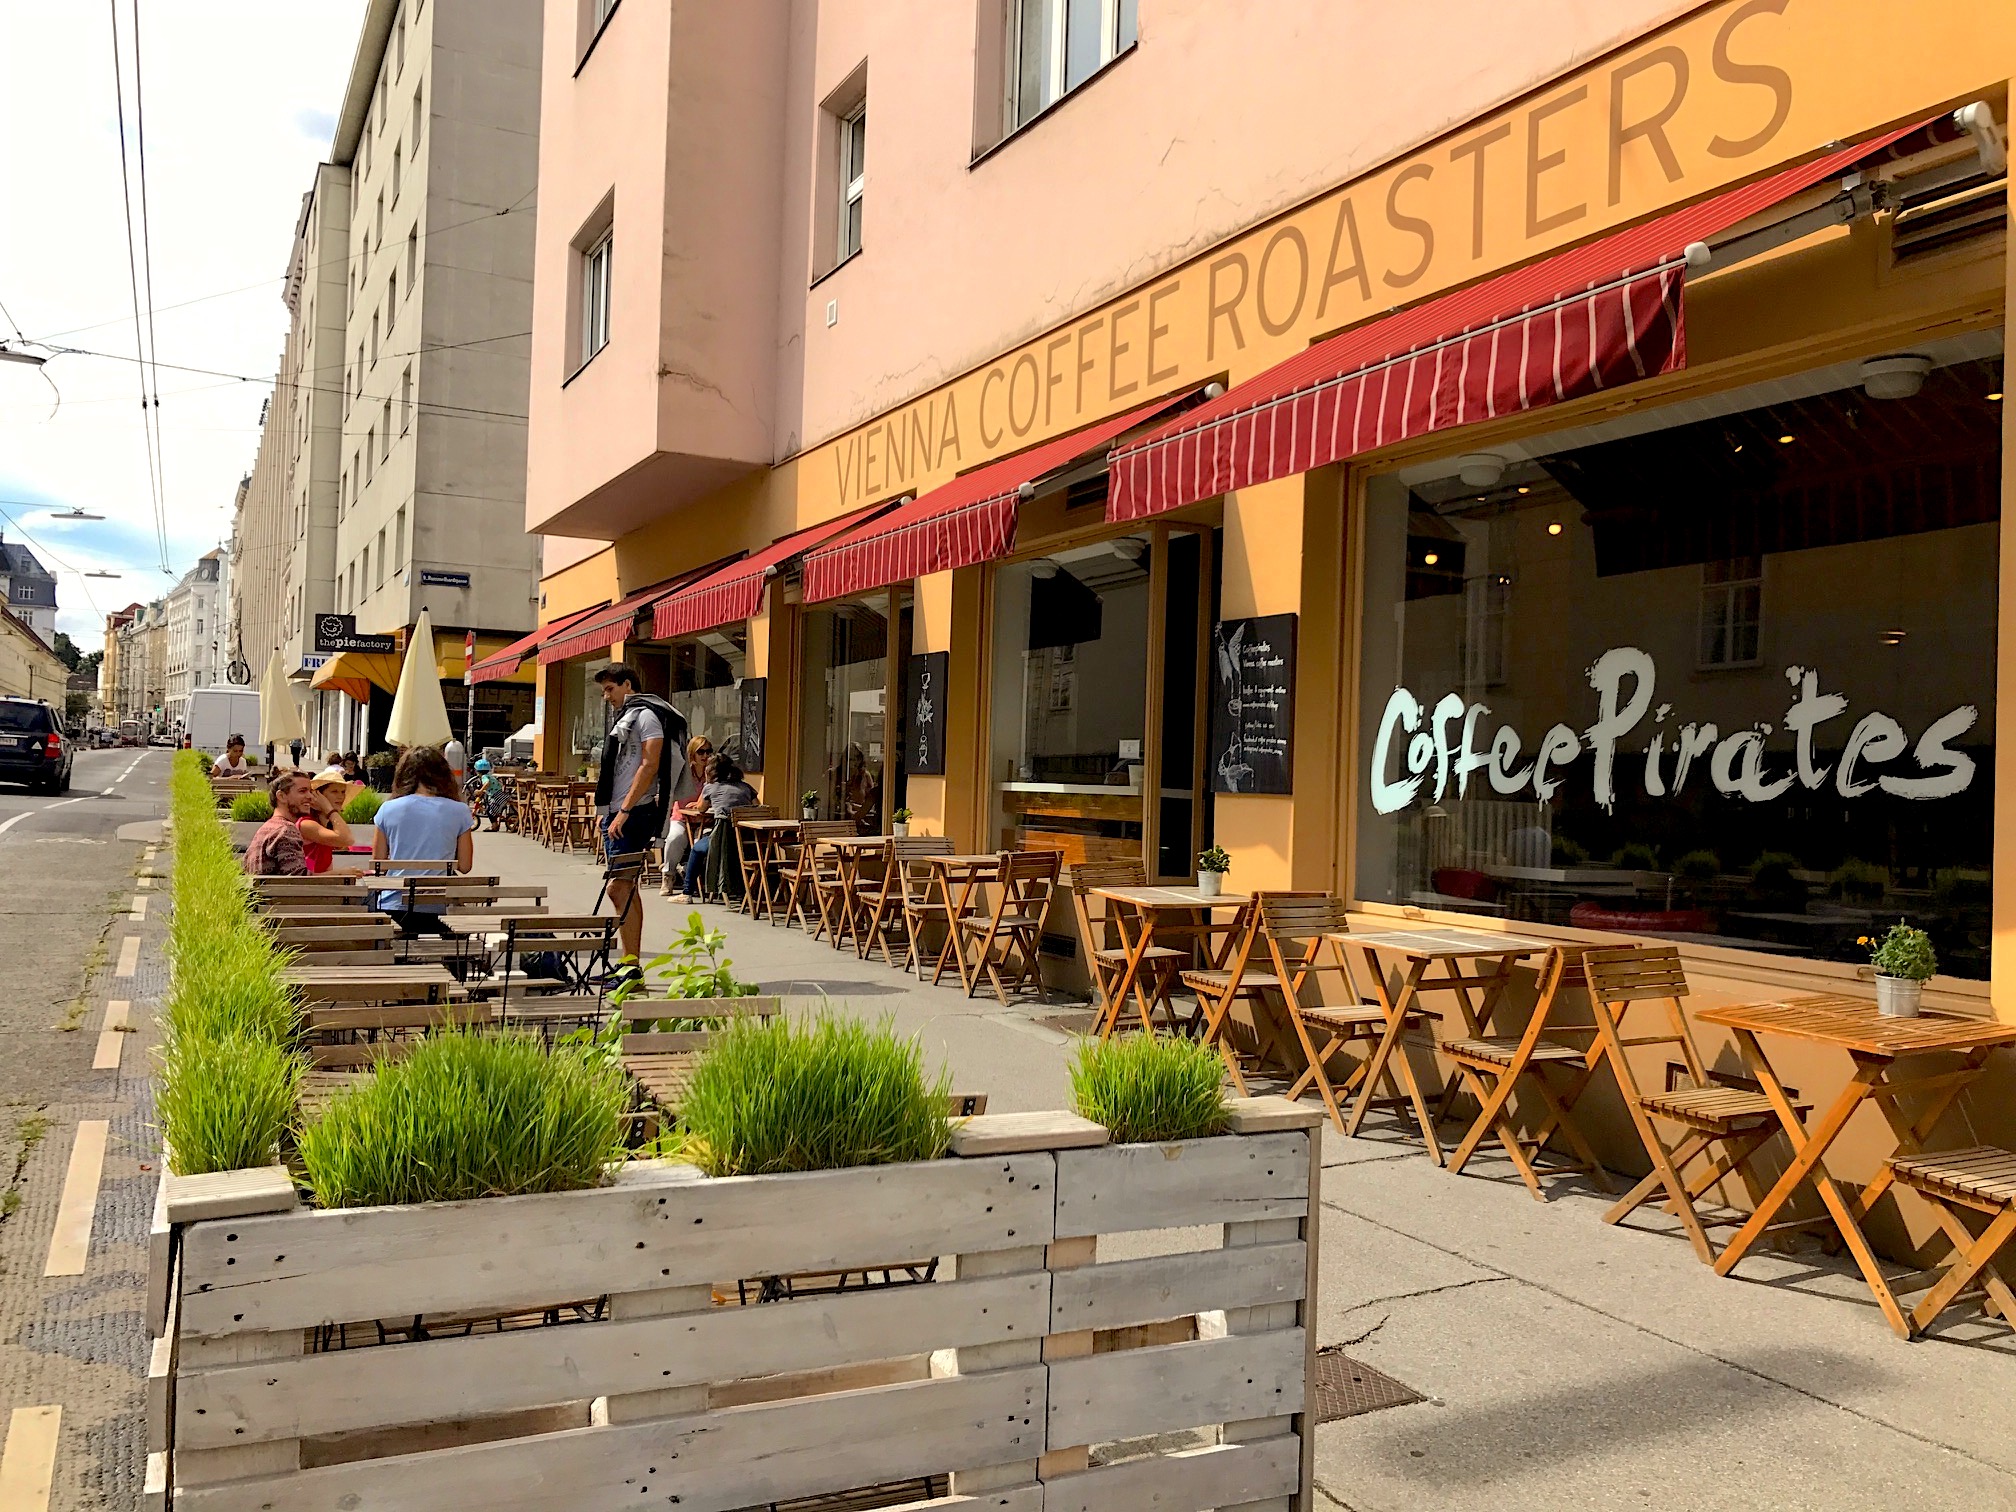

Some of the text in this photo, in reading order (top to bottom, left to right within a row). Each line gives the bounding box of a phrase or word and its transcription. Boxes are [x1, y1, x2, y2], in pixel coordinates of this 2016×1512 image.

[835, 0, 1793, 506] VIENNA COFFEE ROASTERS
